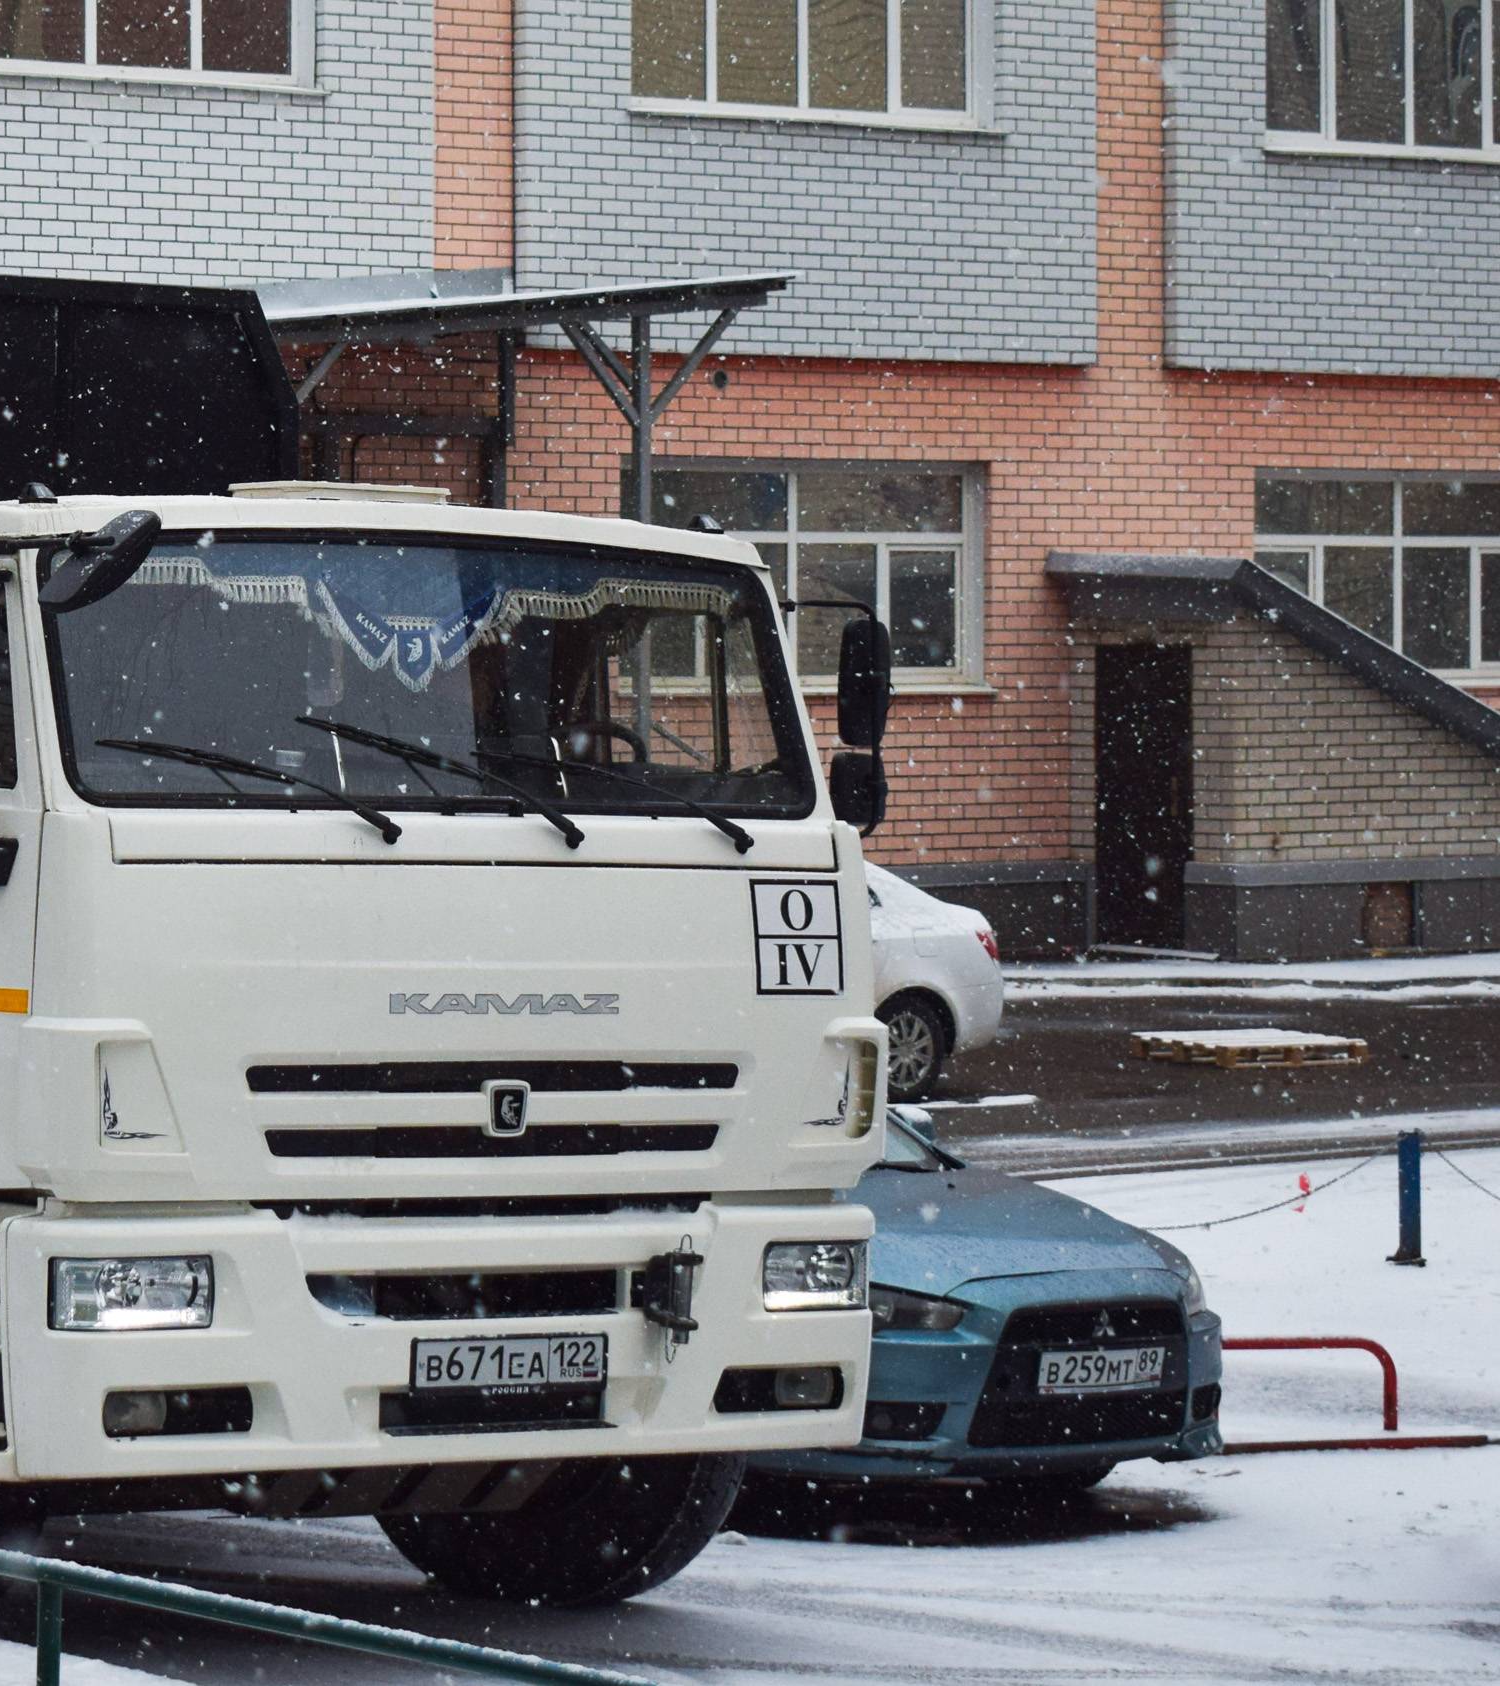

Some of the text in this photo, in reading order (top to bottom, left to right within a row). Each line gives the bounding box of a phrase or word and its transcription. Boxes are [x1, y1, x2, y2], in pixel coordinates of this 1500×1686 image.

[356, 613, 388, 643] KAMAZ
[441, 615, 470, 644] KAMAZ
[773, 943, 824, 986] IV
[389, 993, 619, 1015] KAMAZ
[426, 1340, 596, 1382] В671ЕА 122
[560, 1368, 582, 1377] RUS
[1047, 1350, 1158, 1384] В259МТ 89
[492, 1386, 529, 1395] РОССИЯ
